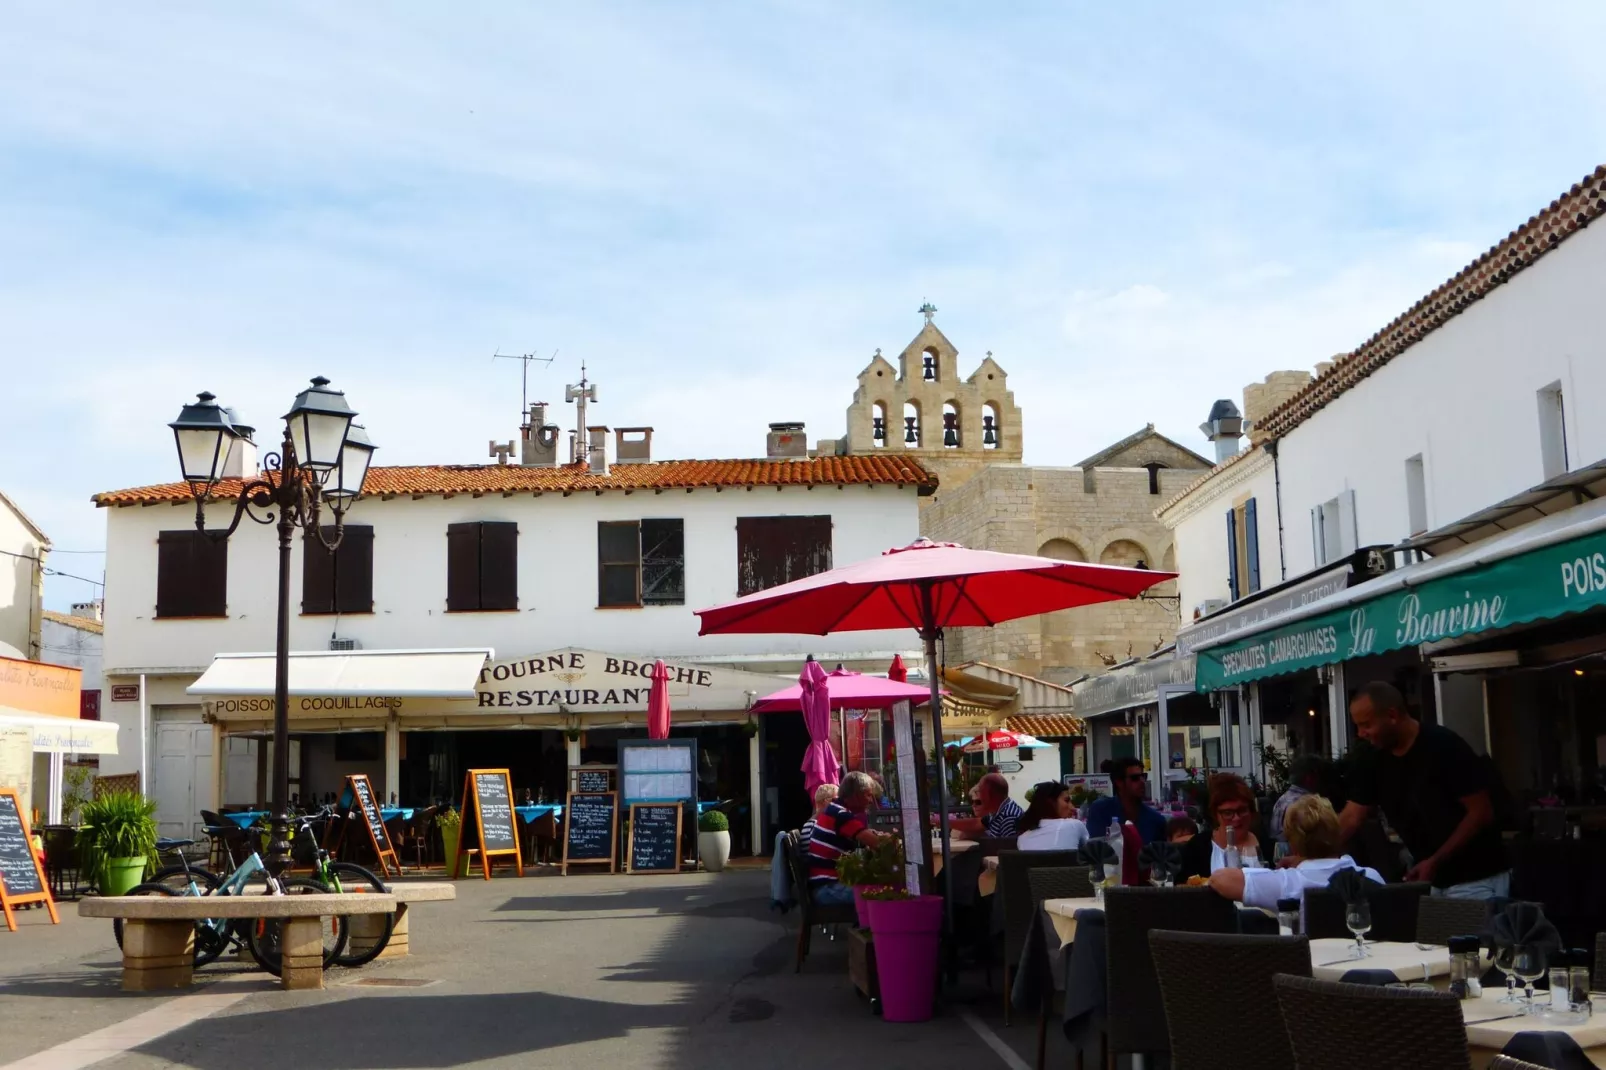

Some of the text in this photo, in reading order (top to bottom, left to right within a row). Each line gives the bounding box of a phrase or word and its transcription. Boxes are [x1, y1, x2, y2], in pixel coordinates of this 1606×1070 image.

[1348, 607, 1377, 657] La
[1396, 591, 1508, 645] Bouvine
[1222, 645, 1266, 677] SPECIALITES
[1268, 625, 1337, 664] CAMARGUAISES
[480, 653, 585, 684] TOURNE
[216, 696, 402, 712] POISSON COQUILLAGES
[478, 688, 652, 708] RESTAURANT
